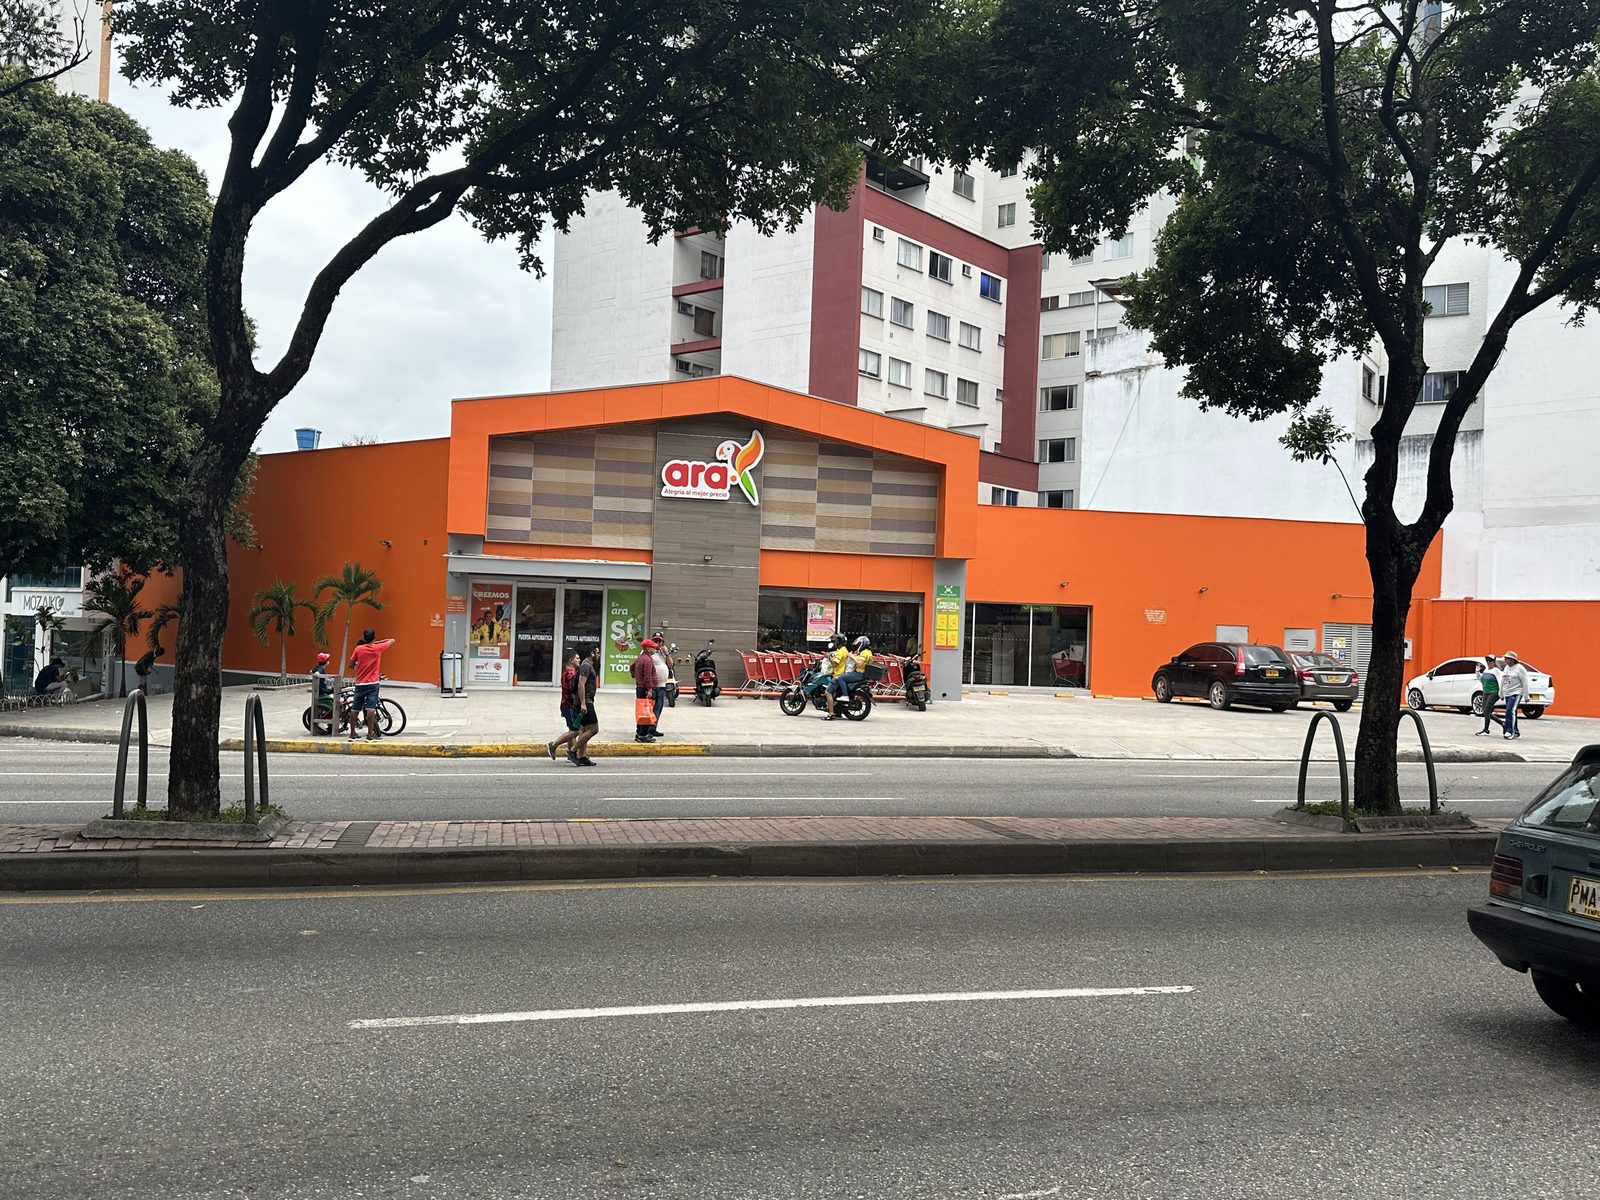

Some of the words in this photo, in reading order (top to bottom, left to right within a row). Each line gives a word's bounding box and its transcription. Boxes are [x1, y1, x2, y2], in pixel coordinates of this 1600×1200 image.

[664, 463, 728, 489] ara
[473, 591, 510, 599] CREEMOS
[611, 607, 629, 615] ara
[609, 663, 631, 673] TOD
[1508, 840, 1548, 854] CHEVROLET
